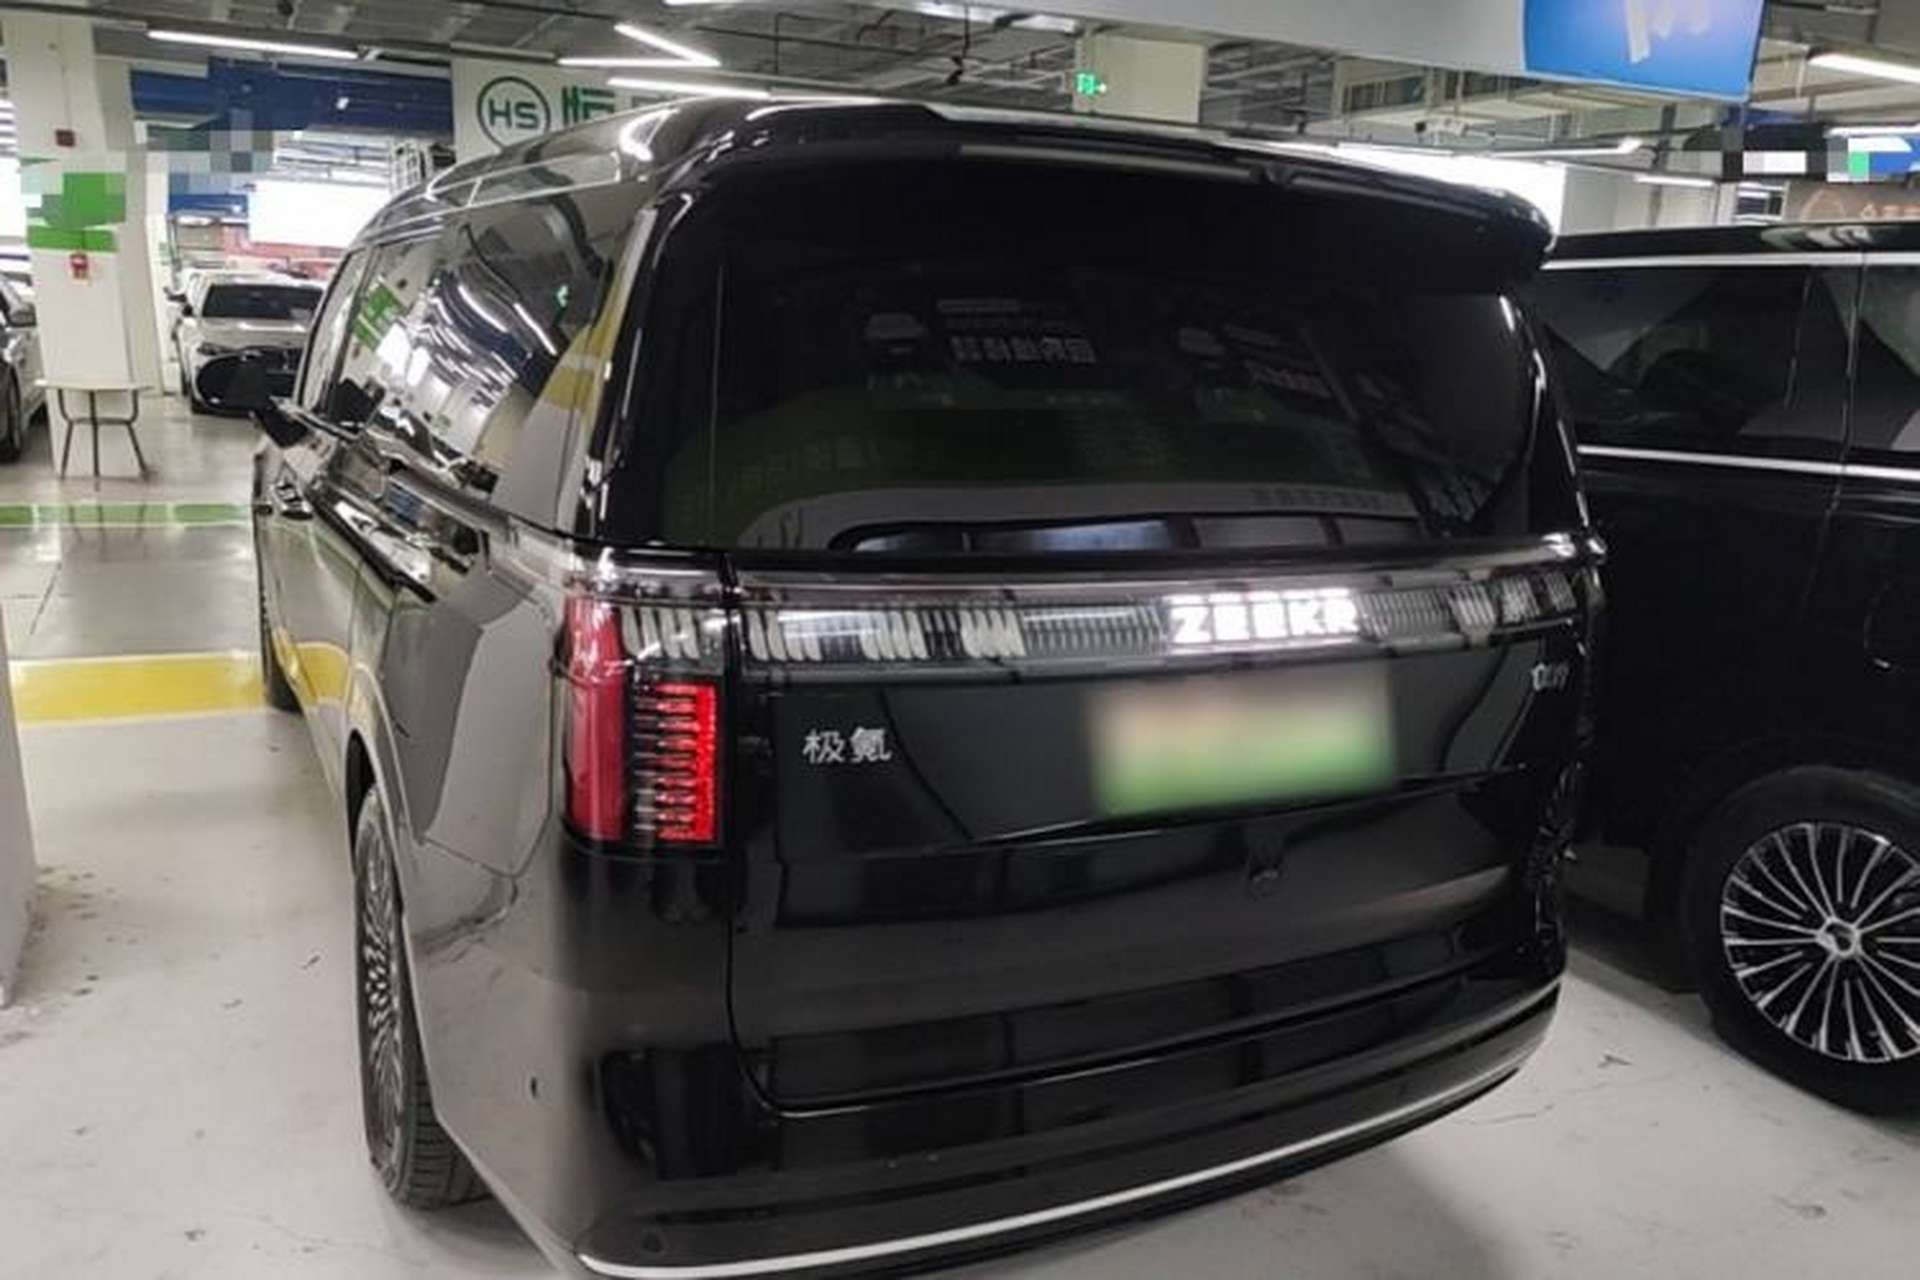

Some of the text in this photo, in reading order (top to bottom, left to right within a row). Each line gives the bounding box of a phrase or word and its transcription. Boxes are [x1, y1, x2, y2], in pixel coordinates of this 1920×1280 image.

[489, 99, 539, 129] HS
[1171, 598, 1359, 643] ZEEKR
[802, 726, 892, 763] 极氪
